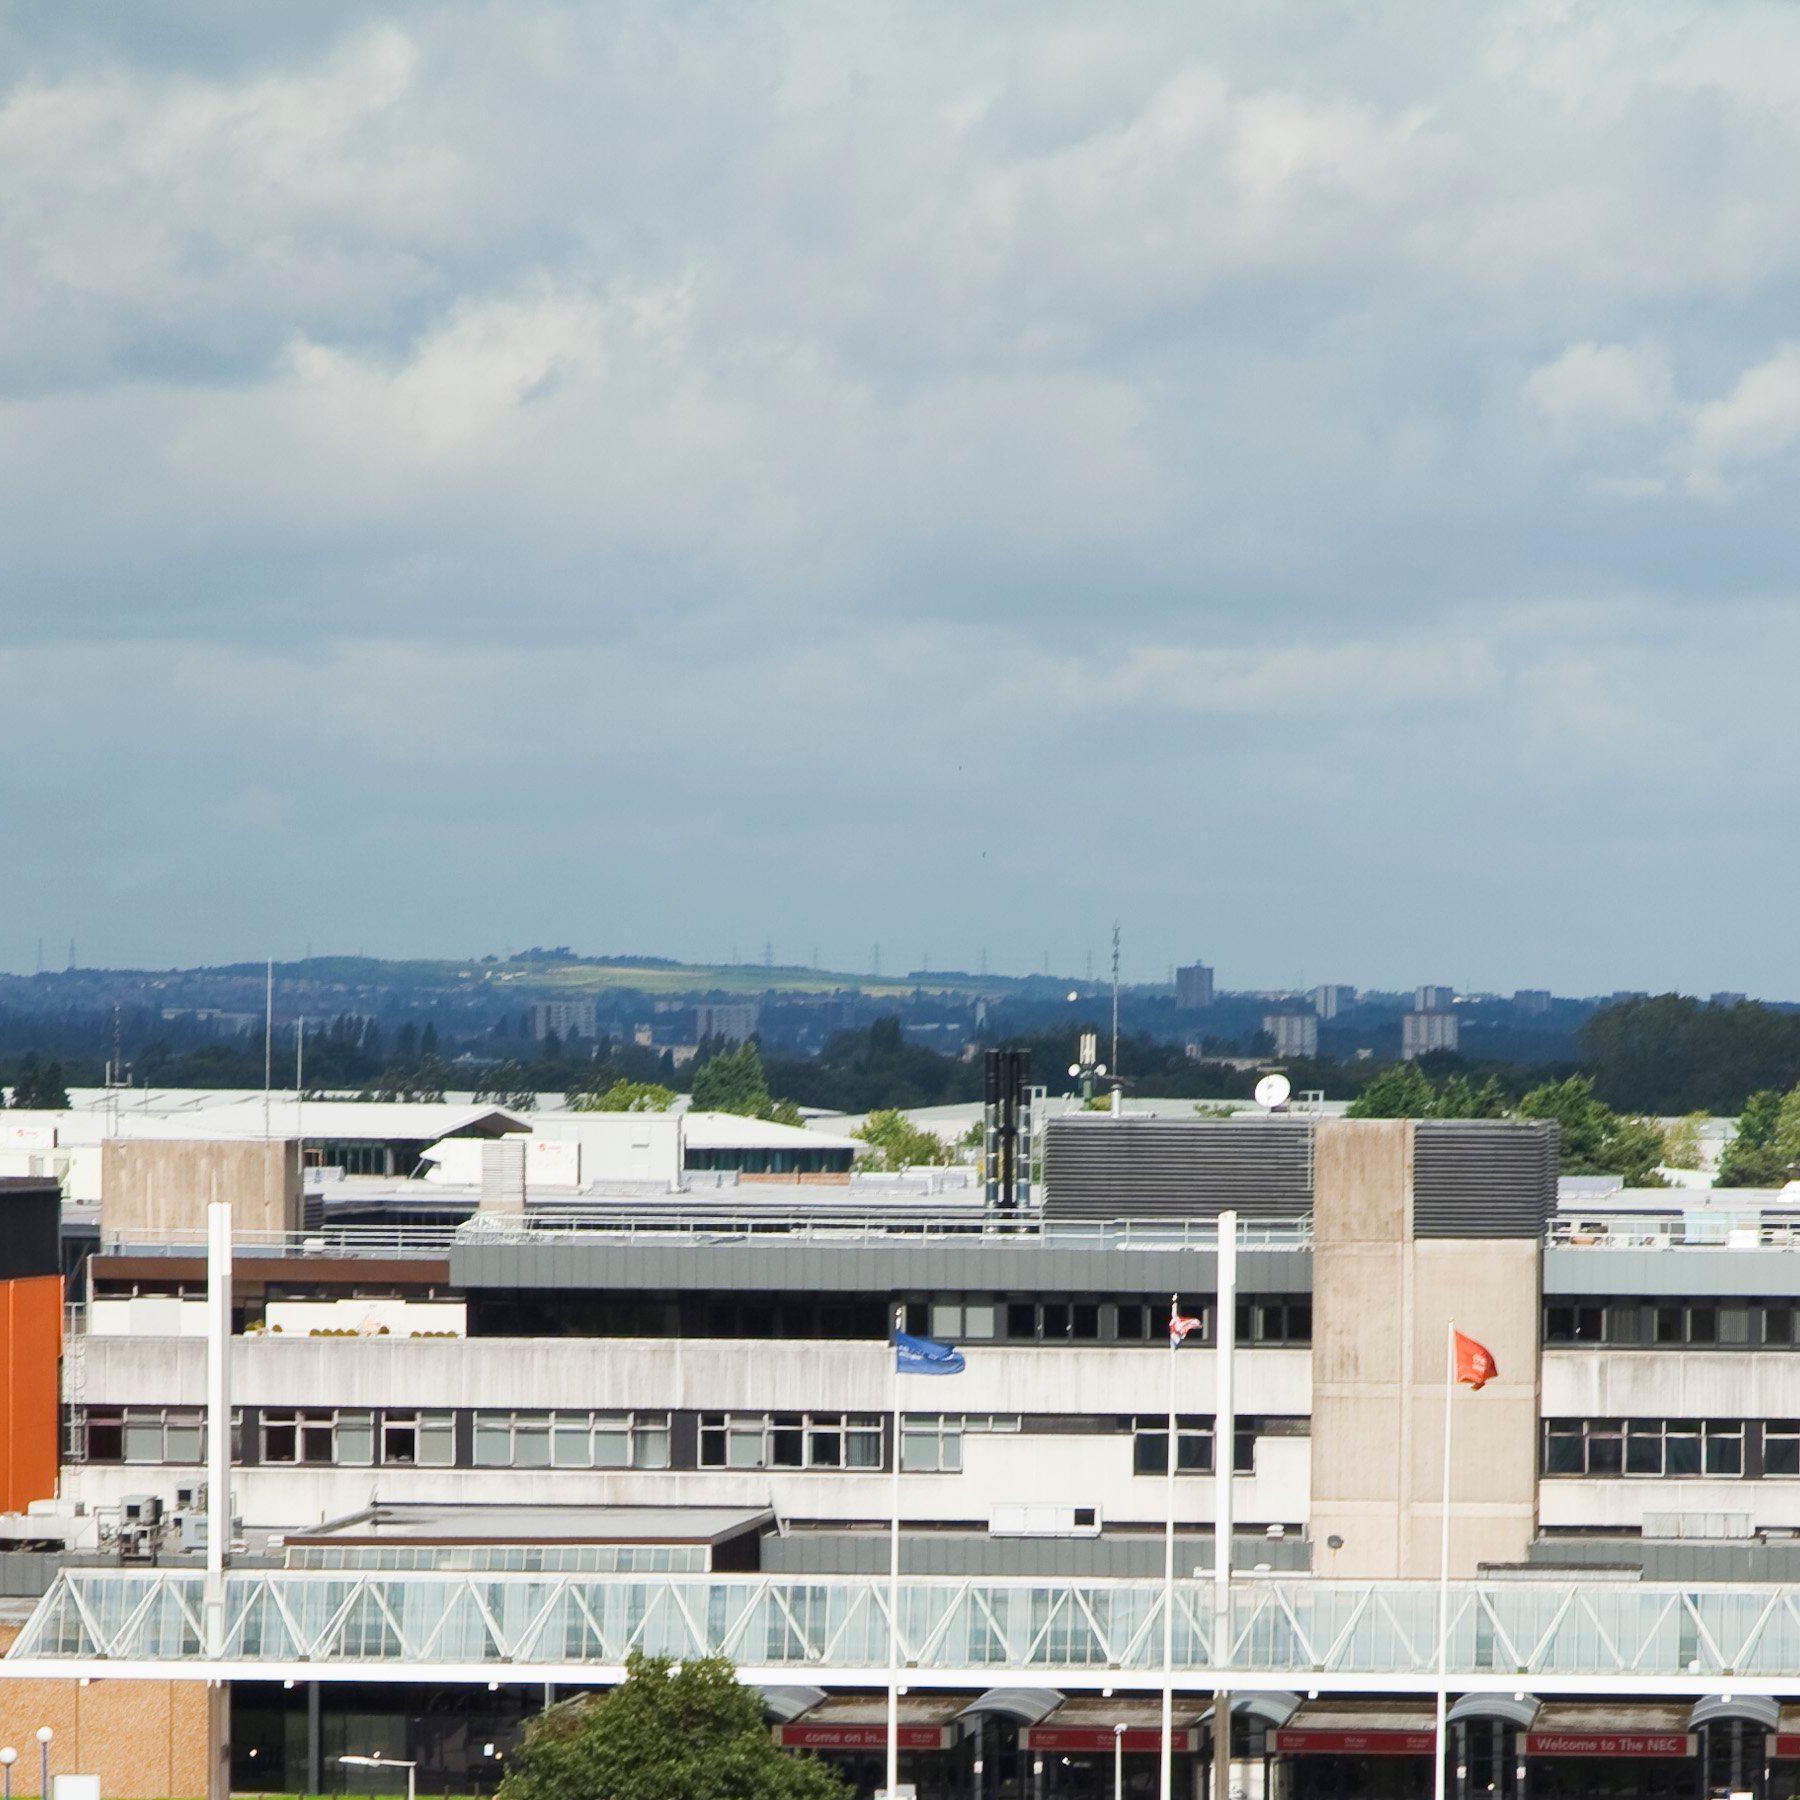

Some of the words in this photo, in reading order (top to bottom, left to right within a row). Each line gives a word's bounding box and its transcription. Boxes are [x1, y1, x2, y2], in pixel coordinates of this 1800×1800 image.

[805, 1732, 840, 1743] come
[844, 1733, 861, 1743] on
[1537, 1737, 1597, 1751] Welcome
[1601, 1738, 1616, 1751] to
[1619, 1738, 1643, 1751] The
[1646, 1739, 1677, 1751] NEC
